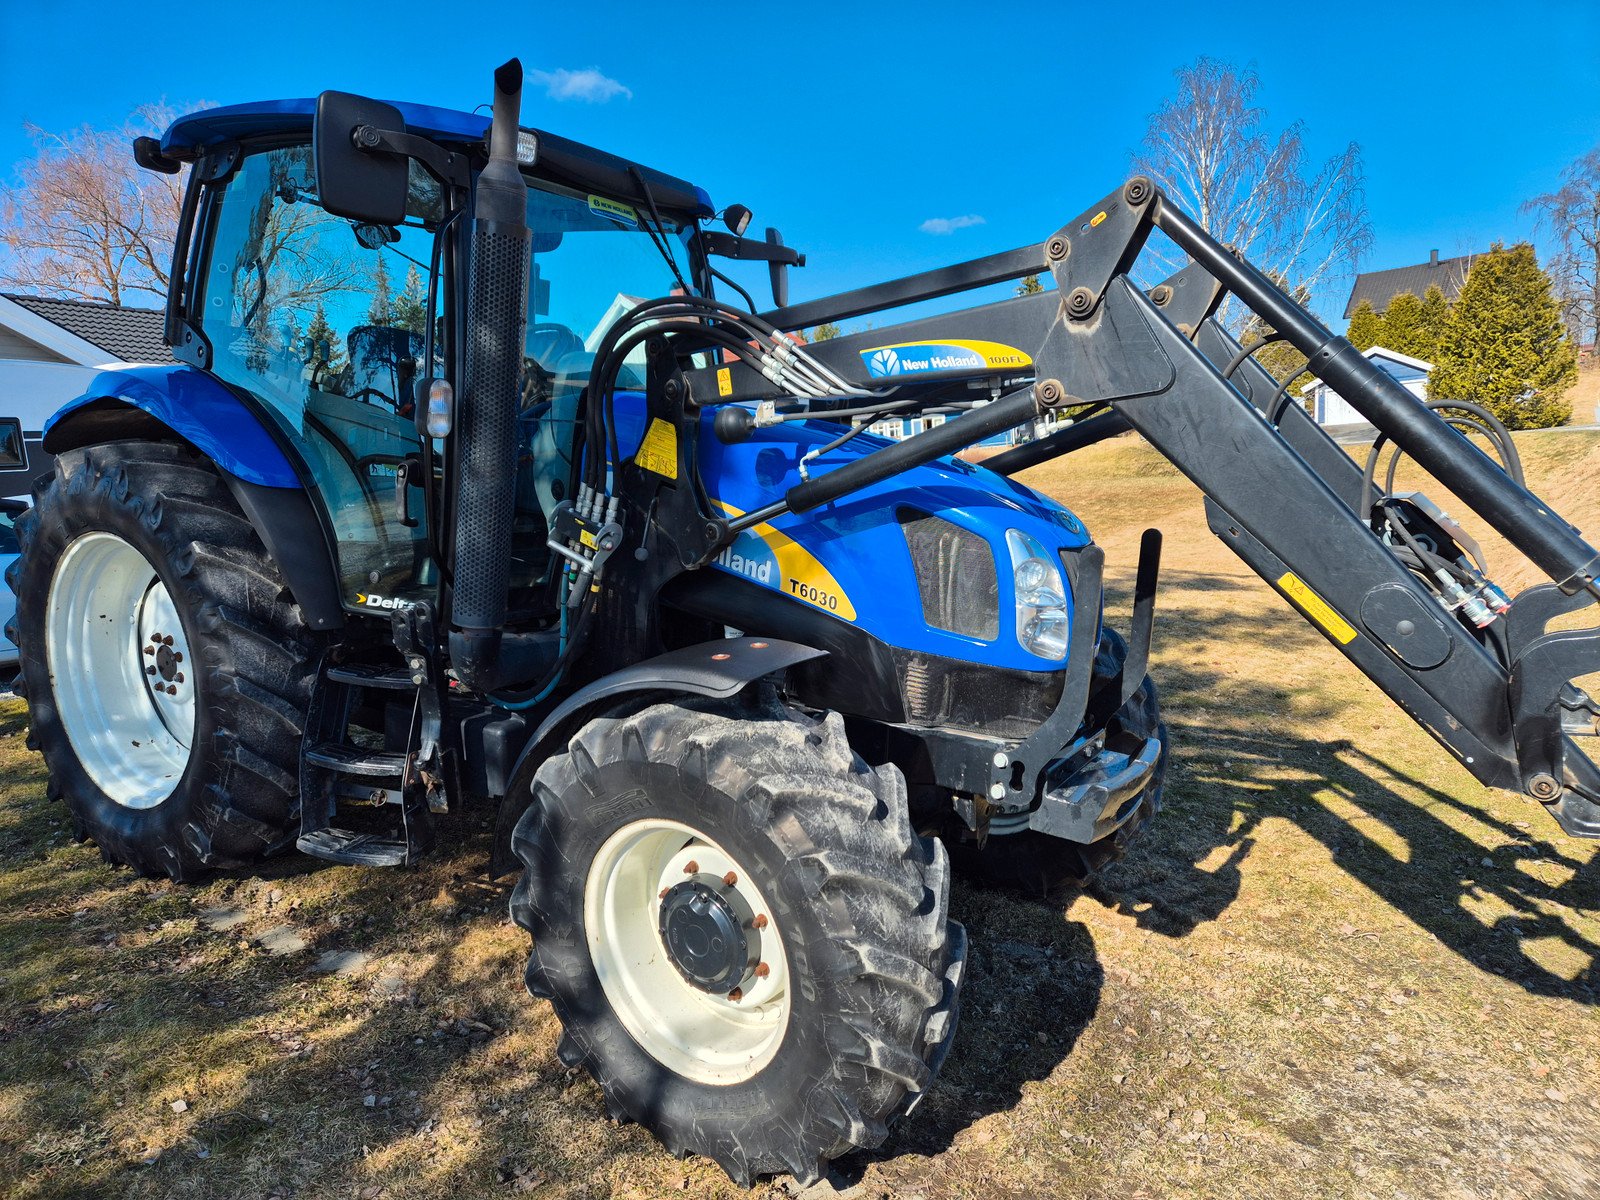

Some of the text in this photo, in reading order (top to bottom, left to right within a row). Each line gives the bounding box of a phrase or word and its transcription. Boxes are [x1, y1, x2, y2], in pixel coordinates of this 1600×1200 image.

[902, 355, 1025, 371] New Holland 100FL
[712, 545, 772, 584] lland
[789, 578, 838, 611] T6030
